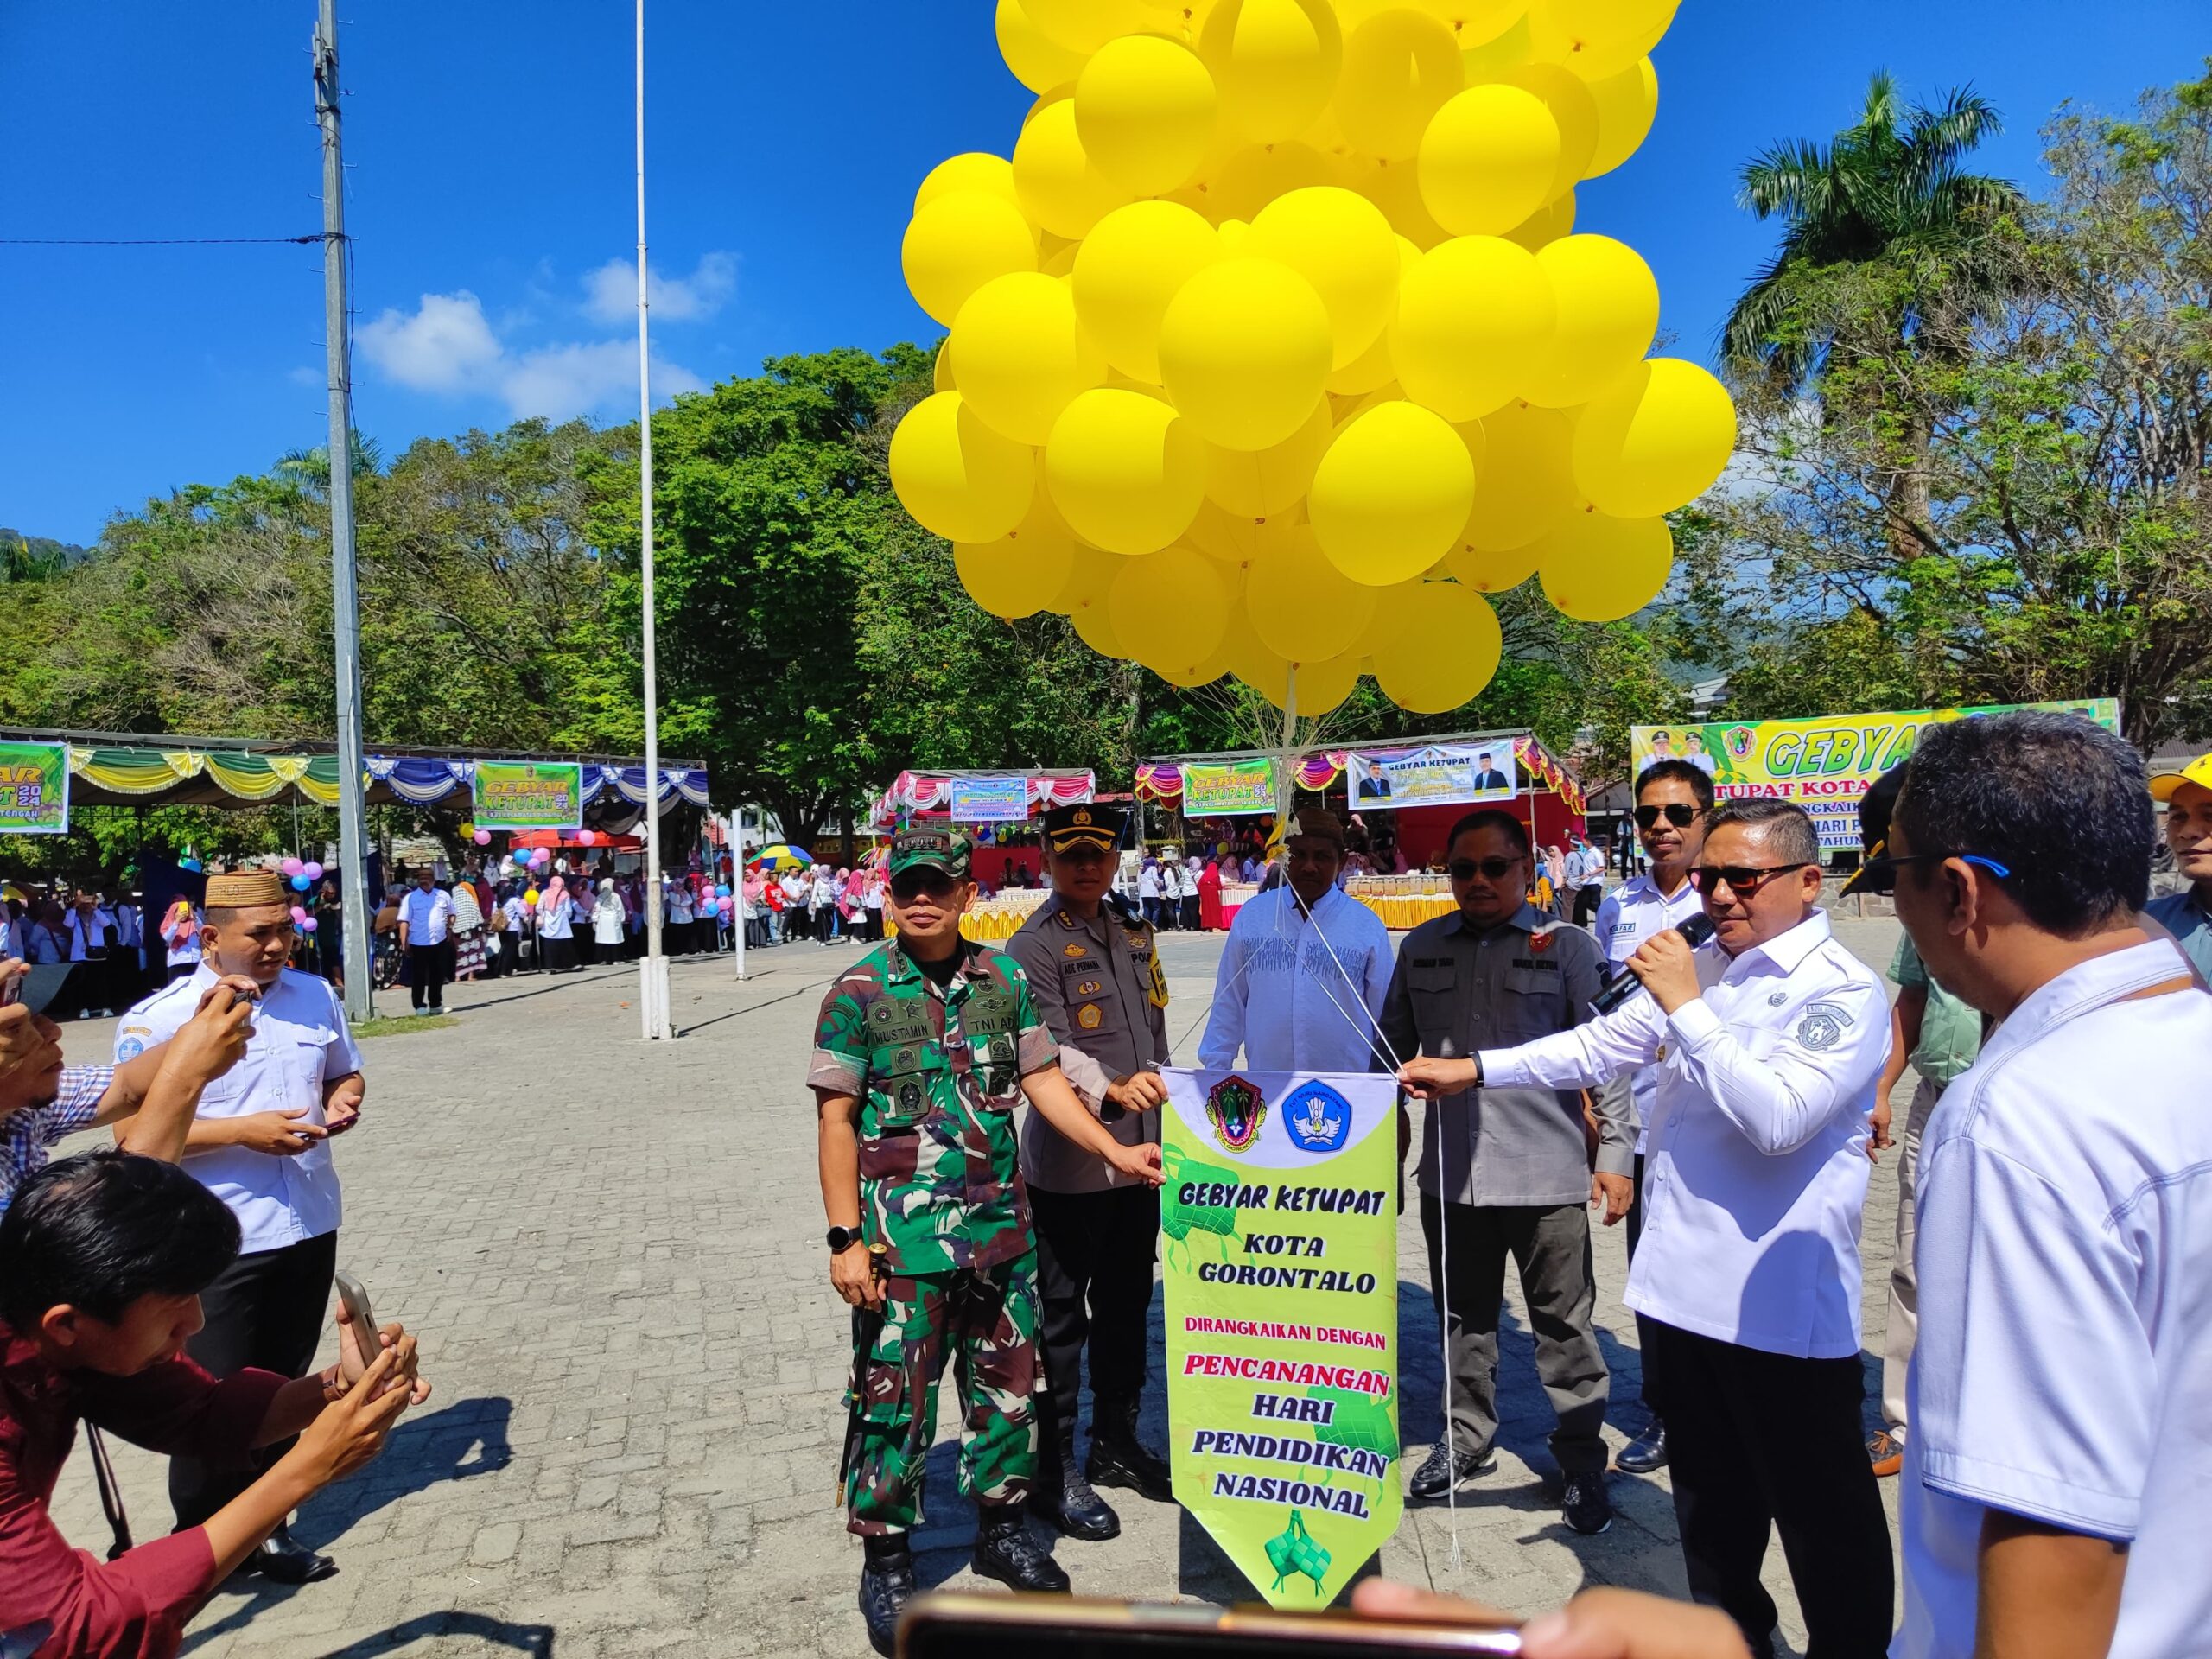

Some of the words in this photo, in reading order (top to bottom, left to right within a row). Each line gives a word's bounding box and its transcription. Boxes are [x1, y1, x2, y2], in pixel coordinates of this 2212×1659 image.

[486, 781, 569, 793] GEBYAR
[1192, 773, 1266, 788] GEBYAR
[484, 795, 555, 810] KETUPAT
[1193, 786, 1253, 802] KETUPAT
[874, 1023, 929, 1045] MUSTAMIN
[970, 1018, 995, 1032] TNI
[1000, 1017, 1016, 1029] AD
[1217, 1128, 1226, 1146] KOTA
[1226, 1131, 1257, 1152] GORONTALO
[1178, 1181, 1269, 1209] GEBYAR
[1274, 1185, 1386, 1216] KETUPAT
[1243, 1233, 1325, 1257] KOTA
[1198, 1262, 1376, 1294] GORONTALO
[1185, 1317, 1311, 1340] DIRANGKAIKAN
[1317, 1327, 1386, 1351] DENGAN
[1183, 1354, 1390, 1396] PENCANANGAN
[1252, 1394, 1335, 1424] HARI
[1192, 1431, 1389, 1479] PENDIDIKAN
[1213, 1473, 1370, 1519] NASIONAL
